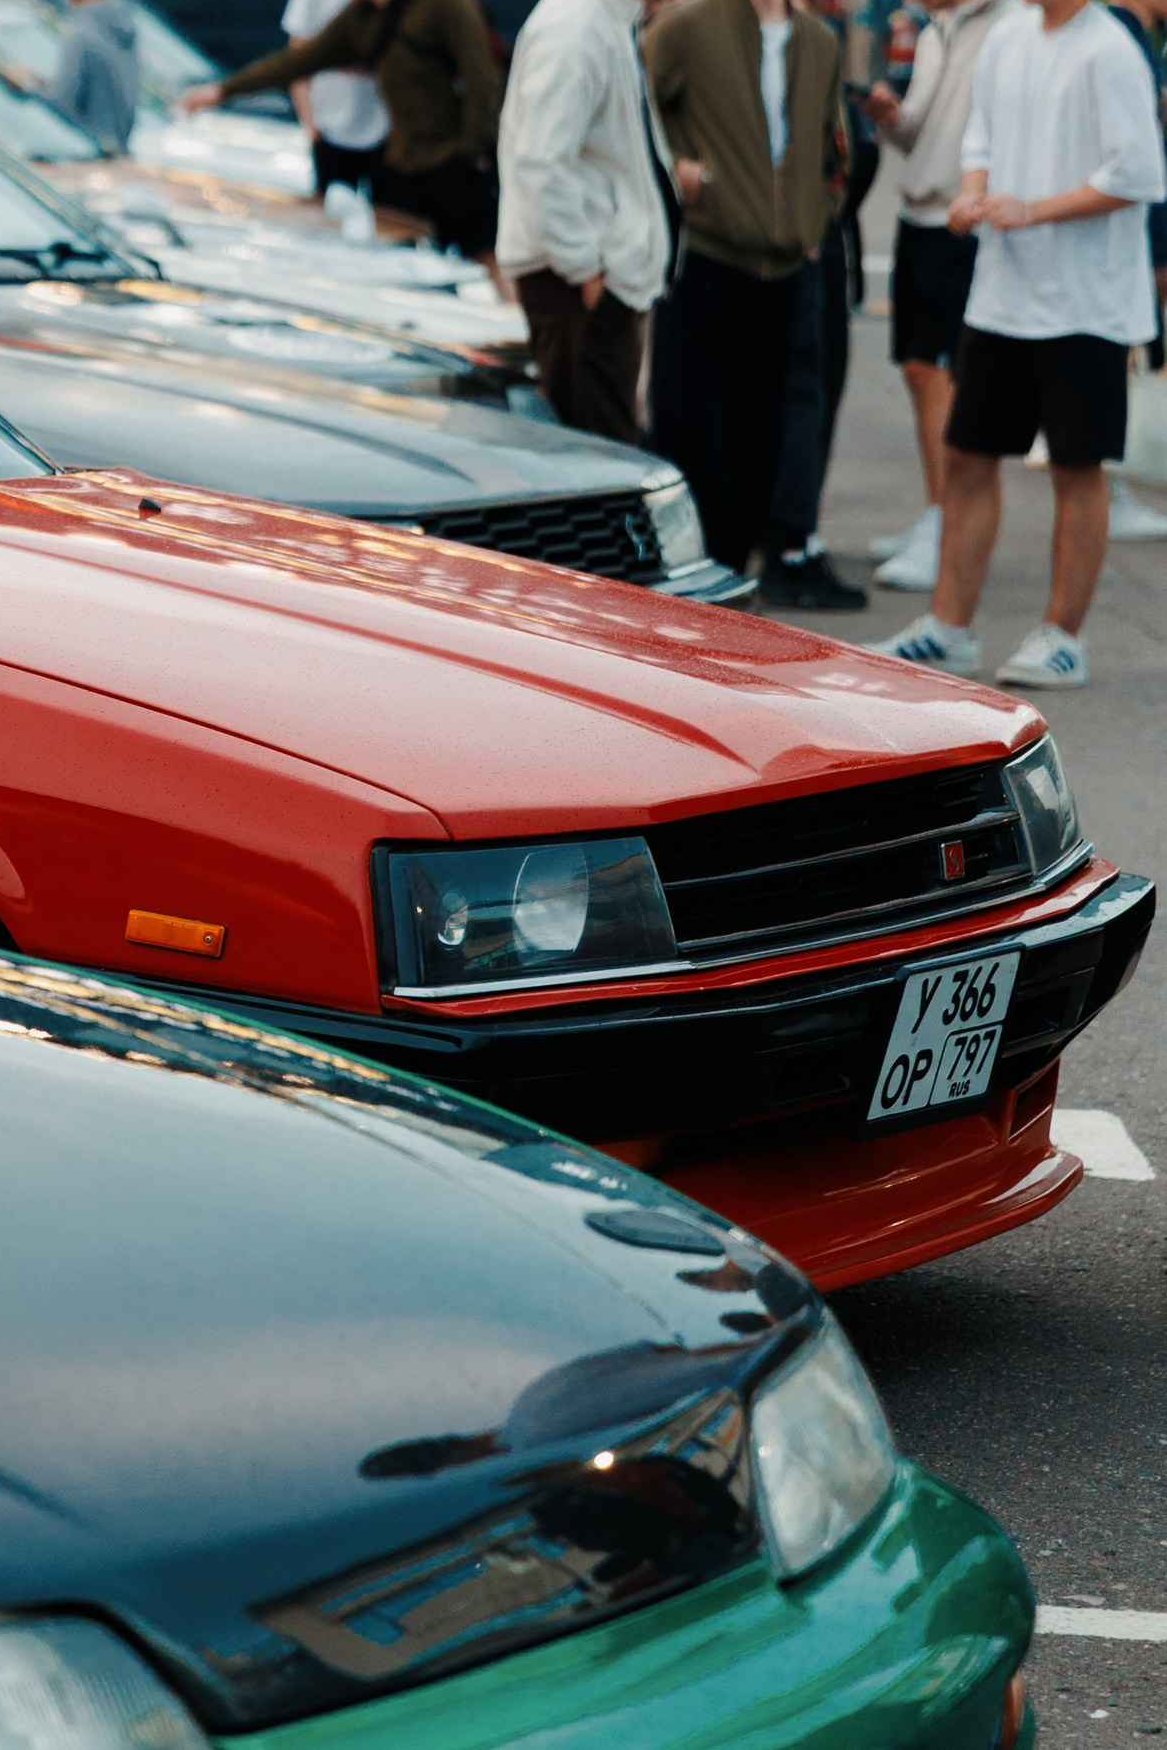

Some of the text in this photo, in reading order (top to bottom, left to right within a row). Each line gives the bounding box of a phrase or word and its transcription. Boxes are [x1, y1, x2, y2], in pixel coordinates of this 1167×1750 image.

[941, 962, 1001, 1027] 366
[946, 1028, 998, 1081] 797
[947, 1081, 971, 1099] RUS
